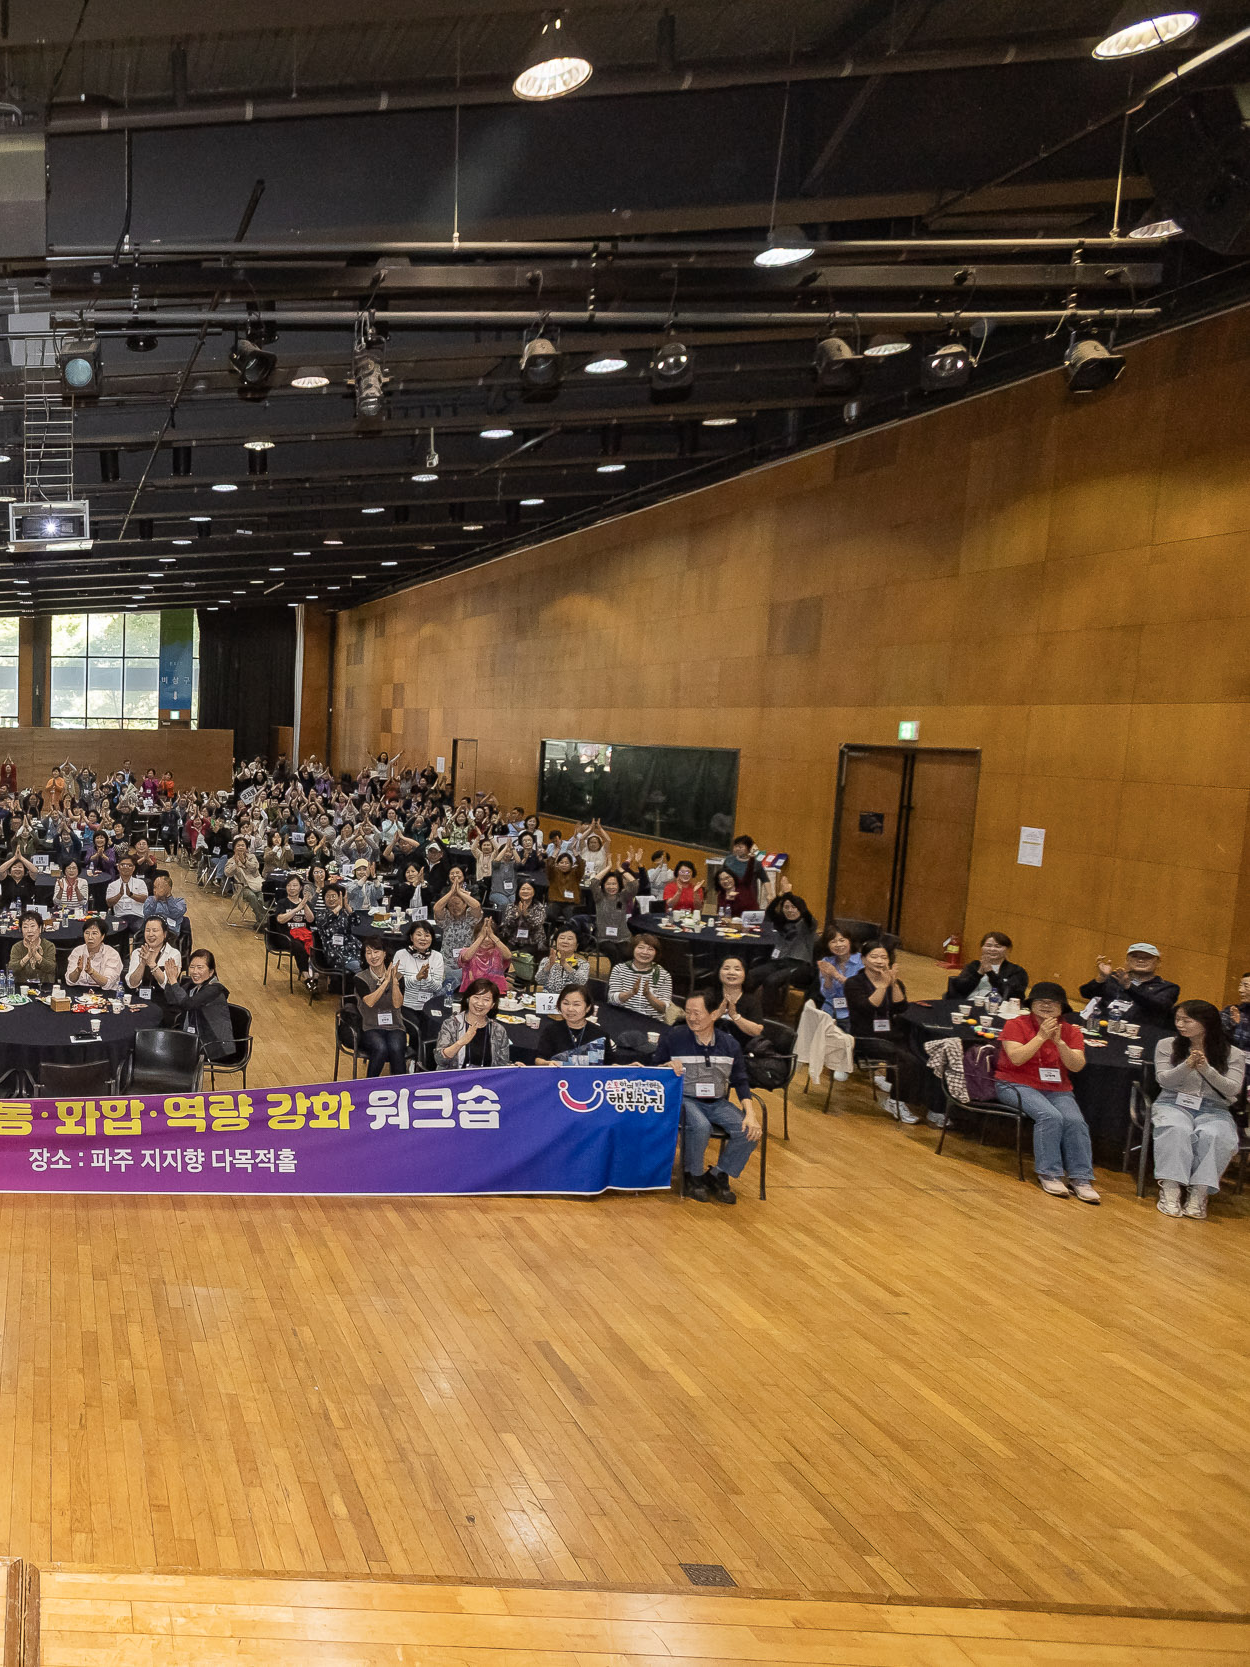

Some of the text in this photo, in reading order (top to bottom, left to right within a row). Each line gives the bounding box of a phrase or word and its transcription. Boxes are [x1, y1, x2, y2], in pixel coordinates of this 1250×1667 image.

[161, 675, 191, 685] 비상구
[548, 995, 554, 1004] 2
[267, 1091, 355, 1130] 강화
[366, 1084, 501, 1131] 워크숍
[607, 1089, 664, 1113] 행복광진
[28, 1147, 72, 1173] 장소
[90, 1147, 135, 1173] 파주
[140, 1147, 206, 1173] 지지향
[211, 1147, 298, 1174] 다목적홀
